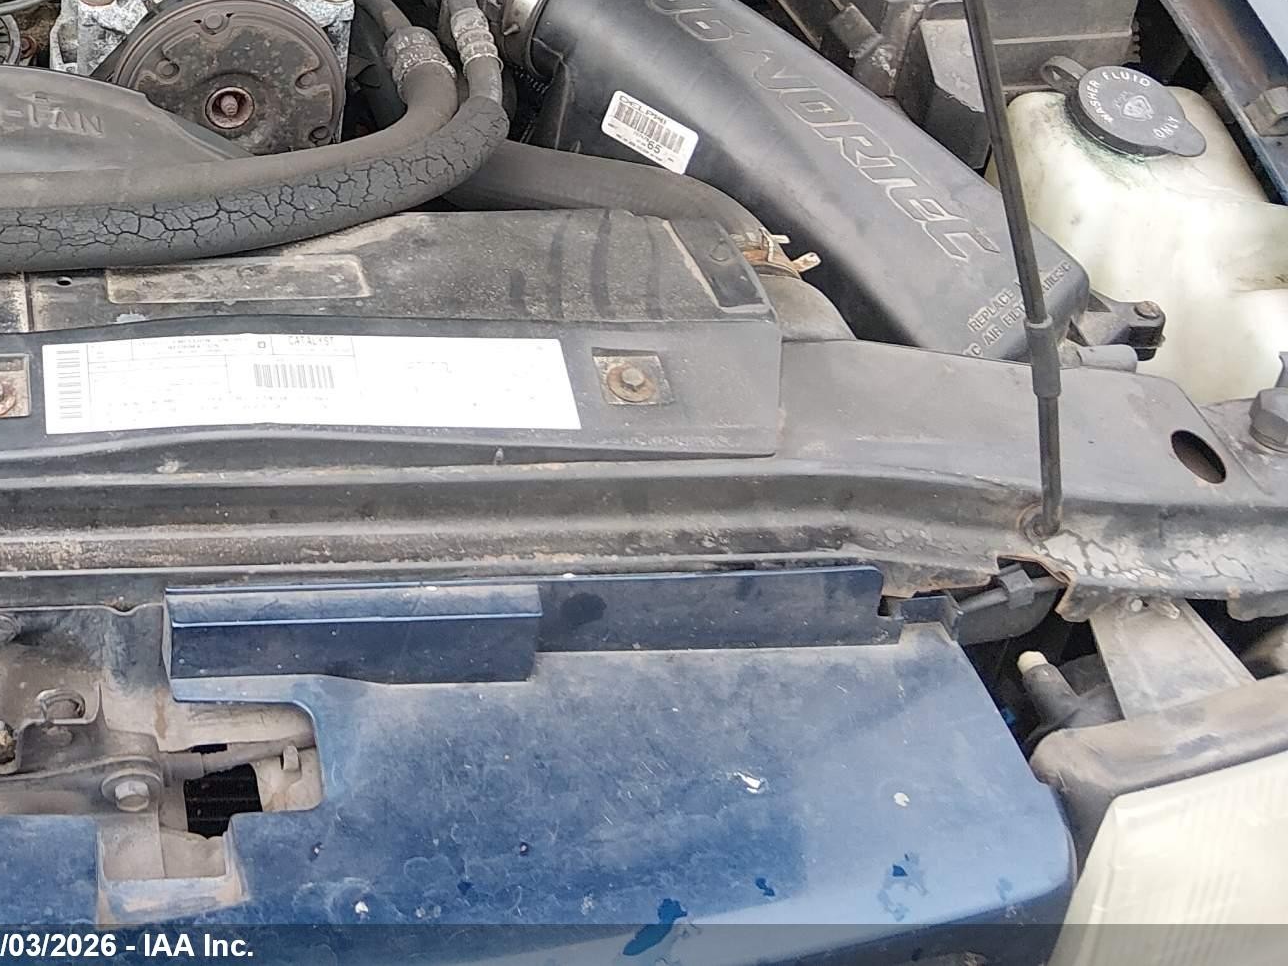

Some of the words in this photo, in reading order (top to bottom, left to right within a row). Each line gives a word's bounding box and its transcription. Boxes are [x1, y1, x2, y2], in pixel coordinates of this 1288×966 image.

[619, 95, 667, 125] DELPHI
[1084, 79, 1114, 124] WASHER
[1102, 71, 1151, 87] FLUID
[646, 140, 662, 154] 65
[1152, 115, 1182, 139] ONLY
[746, 48, 1002, 264] VORTEC
[968, 288, 1015, 332] REPLACE
[983, 325, 1003, 346] AIR
[1003, 302, 1025, 326] FILT
